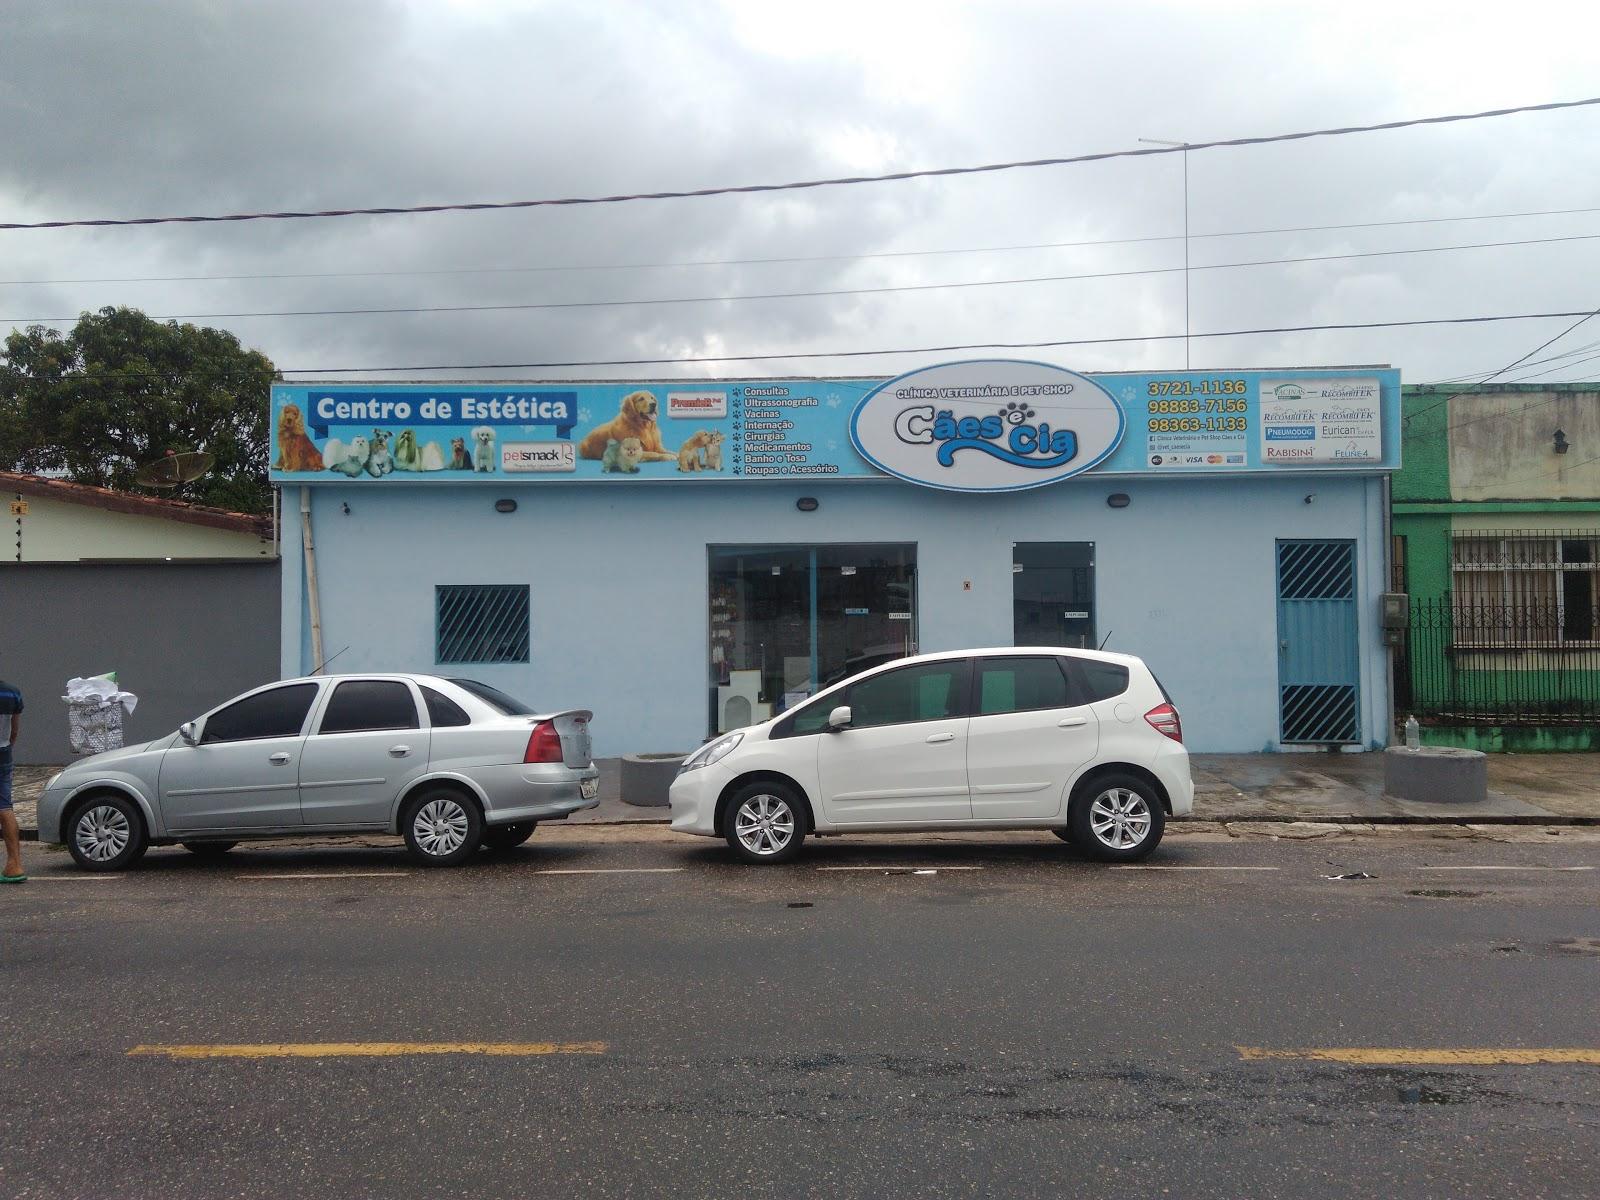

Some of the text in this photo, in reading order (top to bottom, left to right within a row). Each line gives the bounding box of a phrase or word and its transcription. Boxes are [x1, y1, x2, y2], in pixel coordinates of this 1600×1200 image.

[744, 387, 789, 396] Consultas
[896, 385, 1074, 399] CLÍNICA VETERINÁRIA E PET SHOP
[1148, 380, 1247, 396] 3721-1136
[317, 395, 567, 419] Centro de Estética
[744, 397, 818, 408] Ultrassonografia
[1148, 399, 1247, 414] 98883-7156
[744, 410, 780, 418] Vacinas
[744, 421, 794, 430] Internação
[1148, 417, 1247, 432] 98363-1133
[894, 406, 1079, 455] Cães e Cia
[1322, 426, 1356, 435] Eurican
[744, 432, 785, 441] Cirurgias
[744, 443, 811, 452] Medicamentos
[503, 449, 559, 463] petsmack
[745, 454, 775, 463] Banho
[785, 454, 806, 462] Tosa
[745, 466, 779, 475] Roupas
[790, 464, 838, 474] Acessórios
